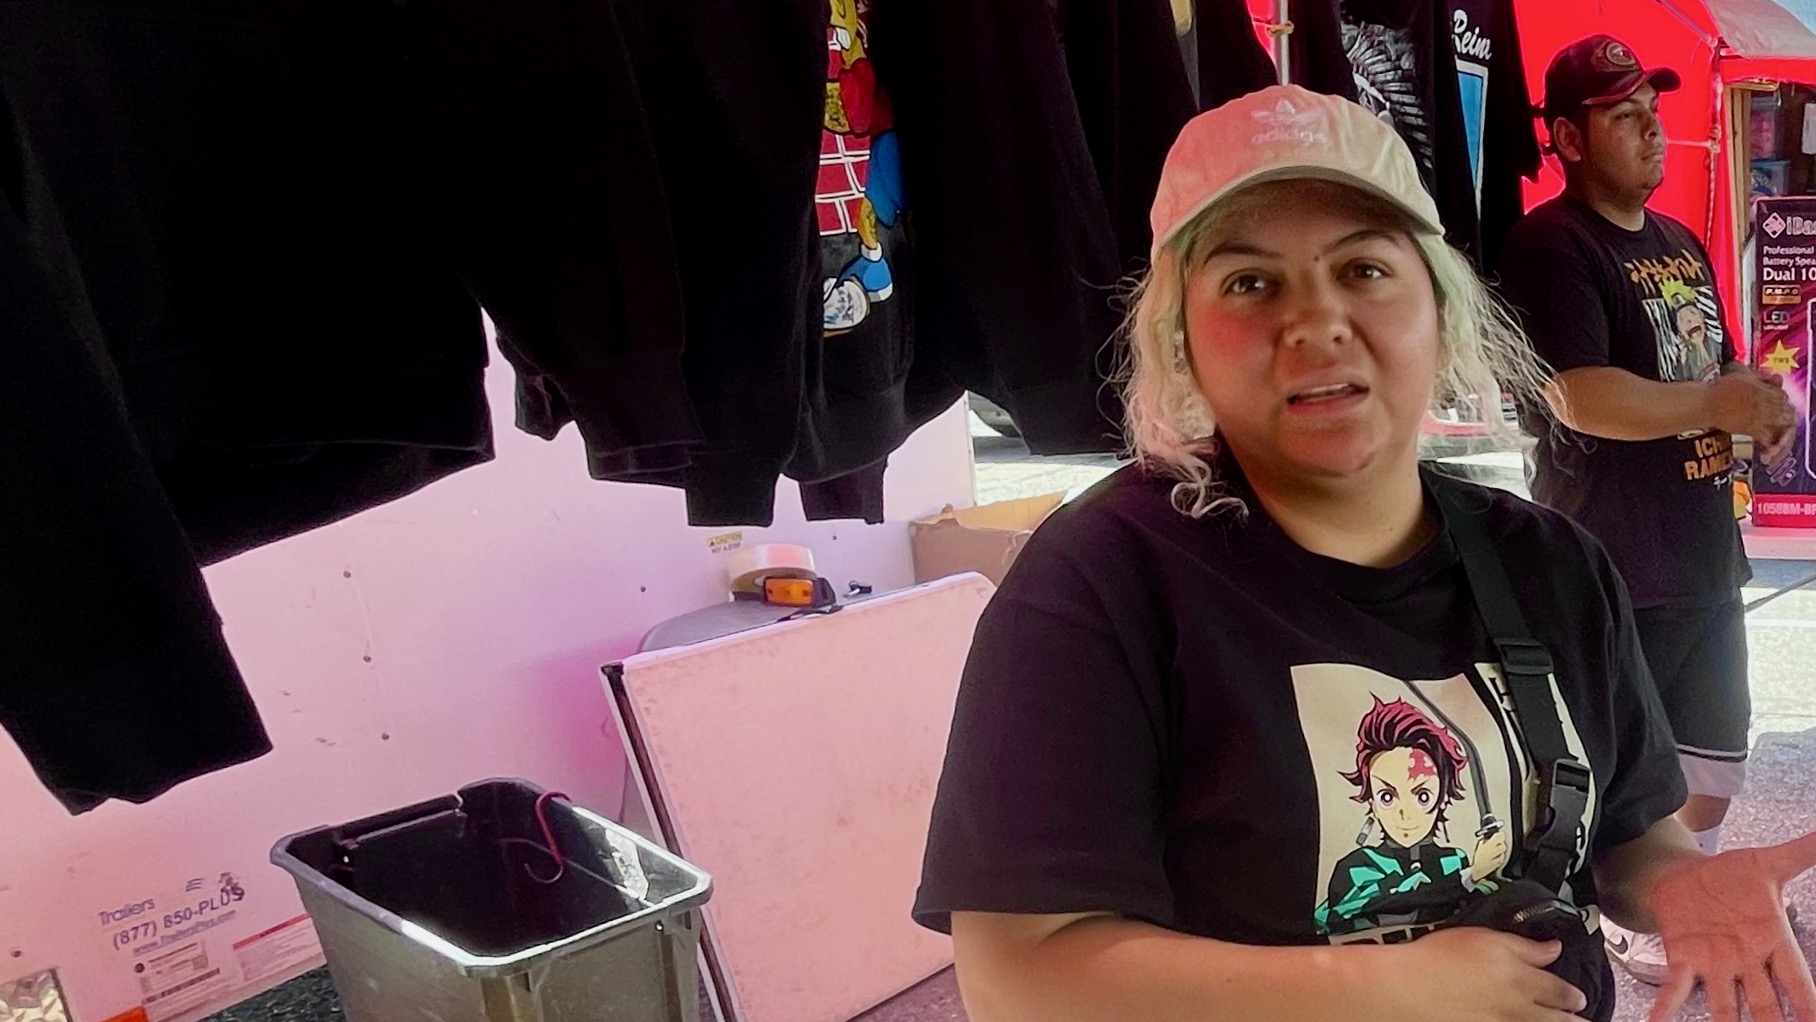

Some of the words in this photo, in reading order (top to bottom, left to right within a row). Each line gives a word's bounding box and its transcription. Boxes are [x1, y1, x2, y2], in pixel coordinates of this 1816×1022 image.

[1252, 124, 1328, 147] adidas
[1763, 245, 1814, 255] Professional
[1763, 256, 1794, 267] Battery
[1763, 268, 1795, 281] Dual
[1764, 311, 1790, 323] LED
[113, 920, 158, 951] (877)
